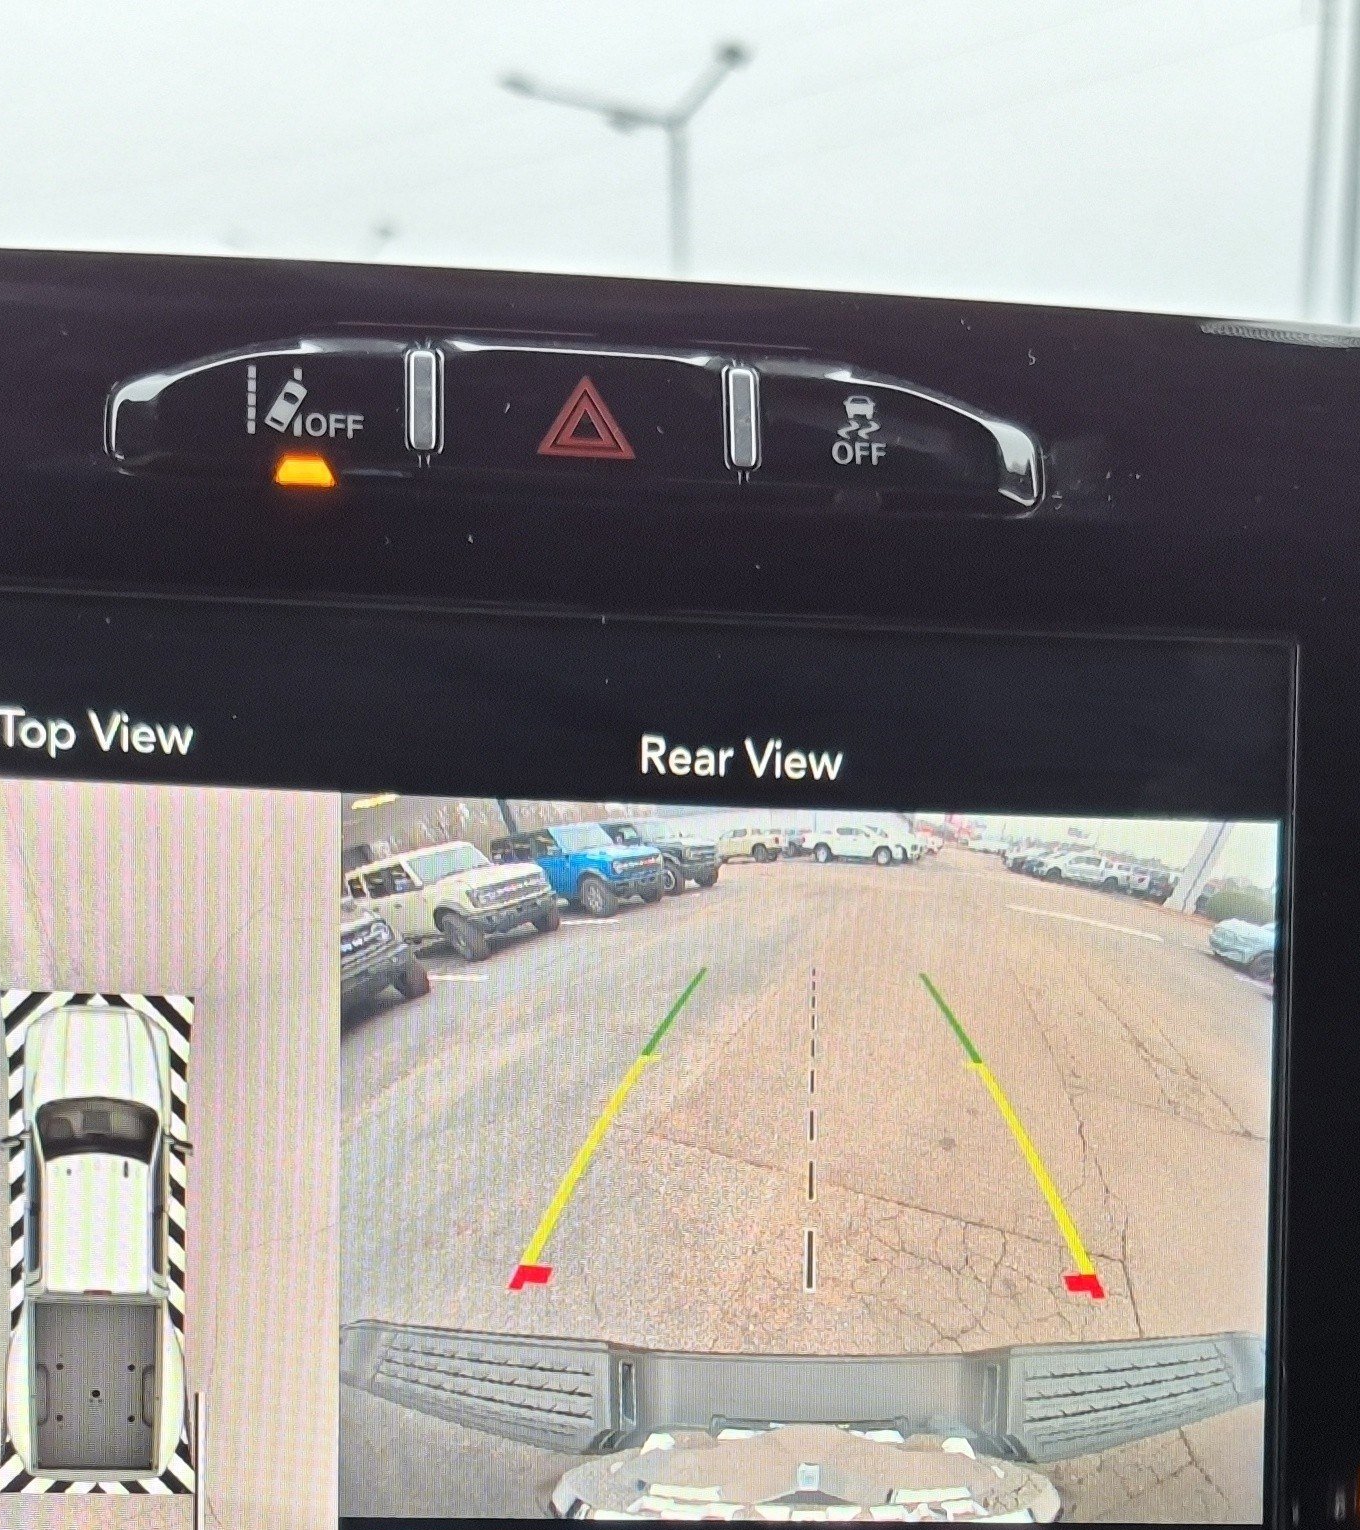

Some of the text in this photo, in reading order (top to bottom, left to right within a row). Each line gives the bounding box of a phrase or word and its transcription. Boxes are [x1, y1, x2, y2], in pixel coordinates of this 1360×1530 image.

[306, 412, 364, 440] OFF
[831, 439, 887, 466] OFF
[87, 709, 194, 756] View
[641, 734, 844, 781] Rear View
